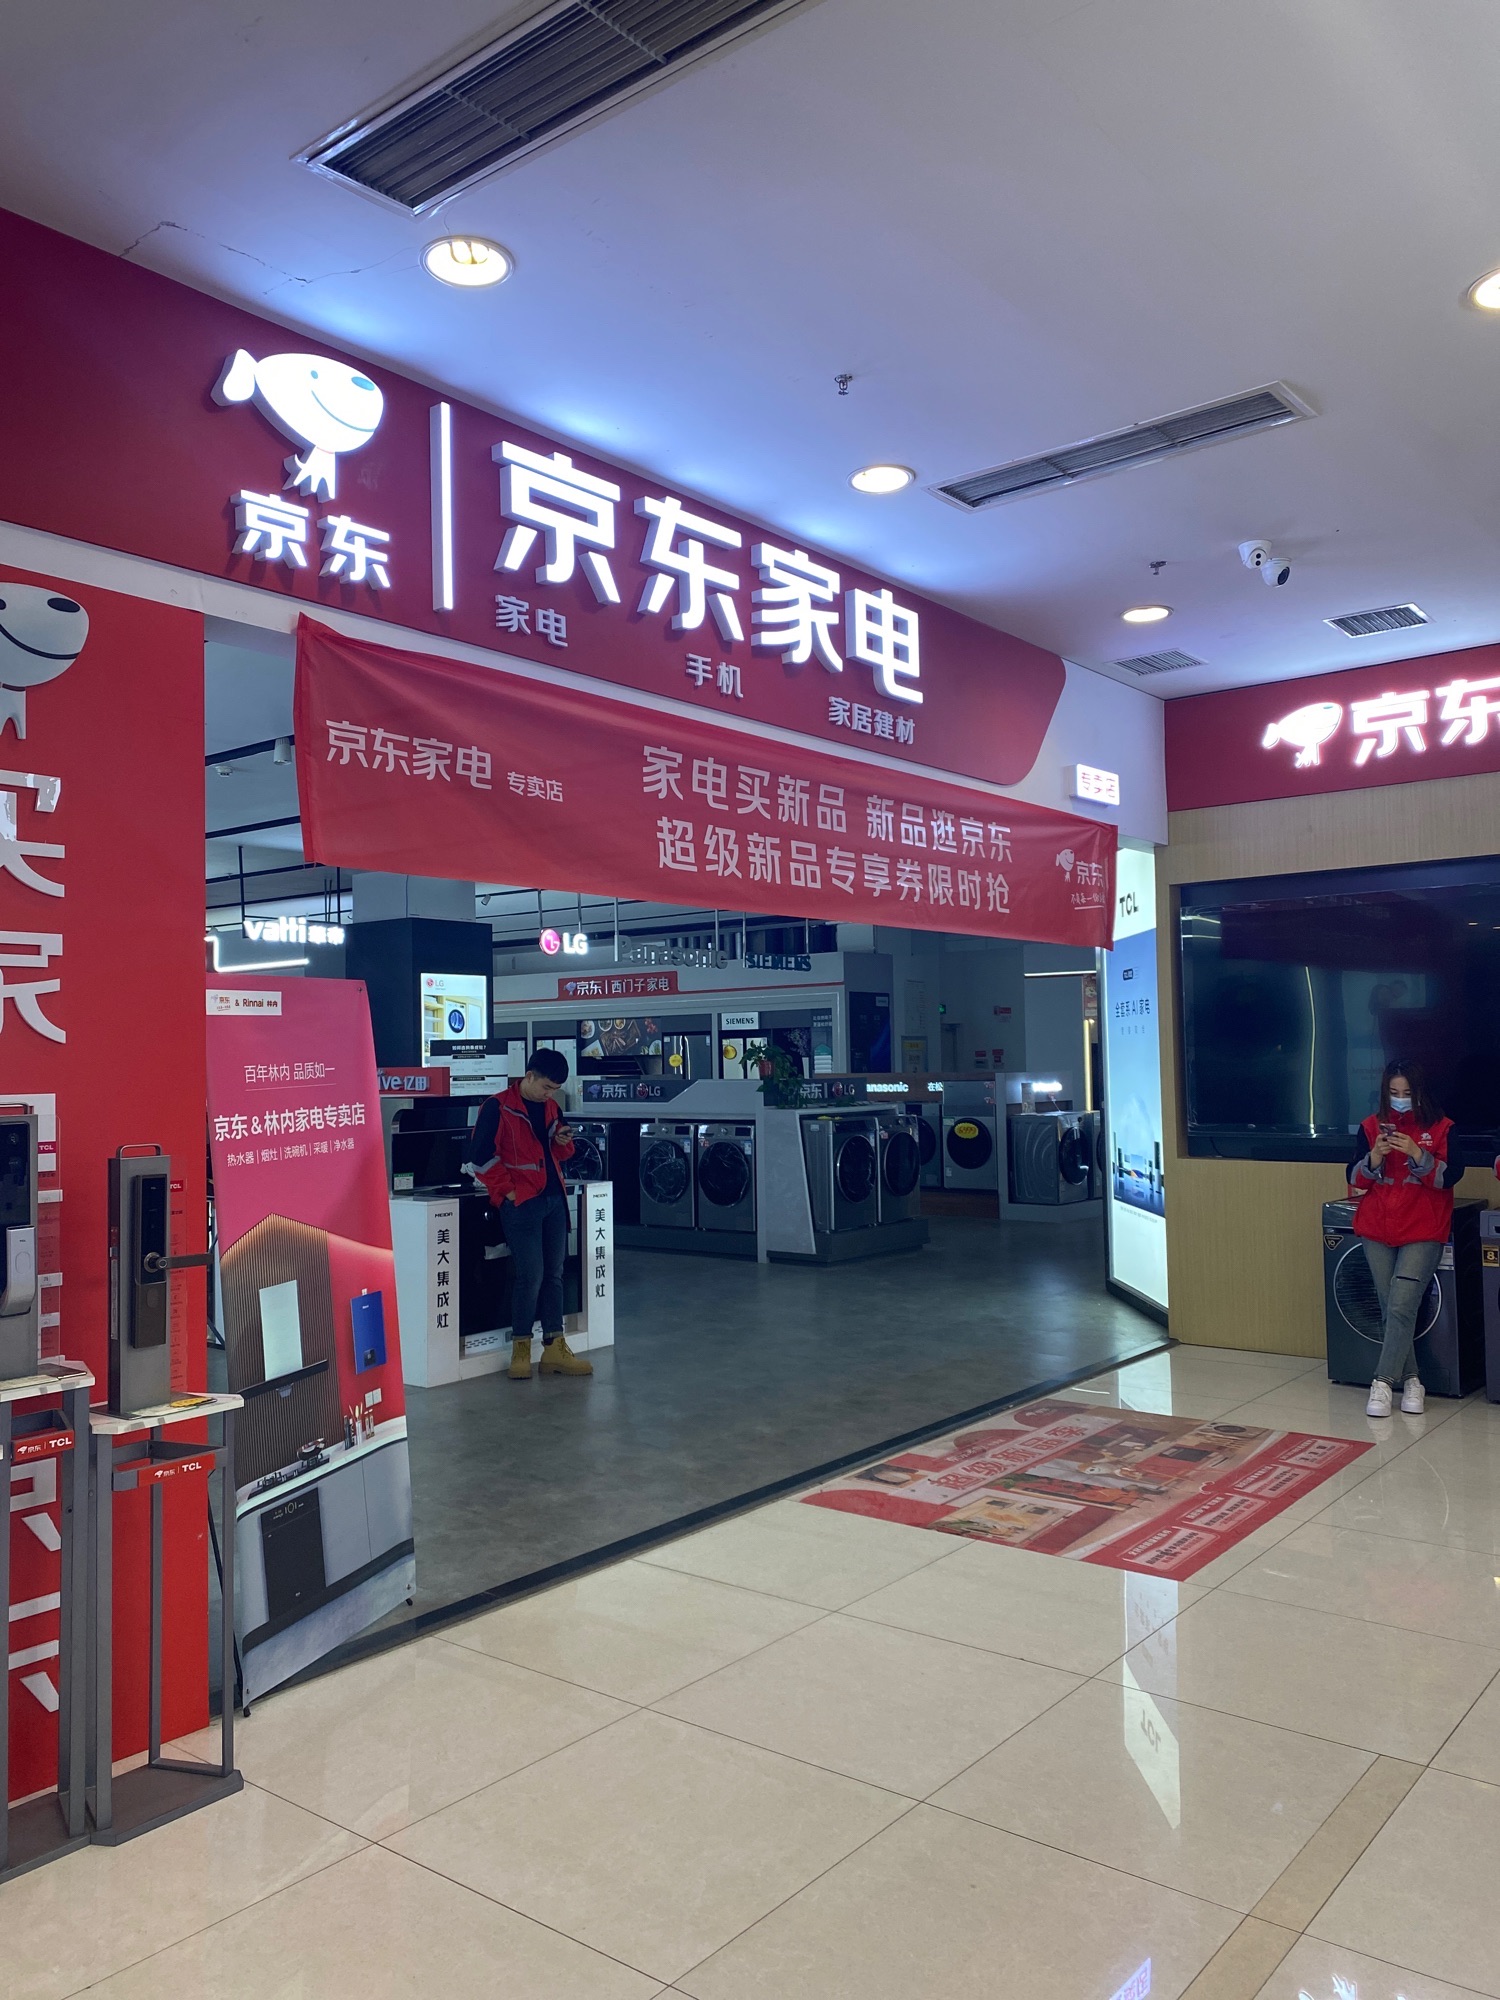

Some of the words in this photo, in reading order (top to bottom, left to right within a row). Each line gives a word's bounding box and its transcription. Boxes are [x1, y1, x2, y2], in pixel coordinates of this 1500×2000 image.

[234, 489, 391, 589] 京东
[493, 440, 924, 704] 京东家电
[495, 594, 568, 648] 家电
[686, 653, 743, 698] 手机
[828, 695, 916, 746] 家居建材
[1350, 677, 1500, 765] 京东
[325, 719, 492, 790] 京东家电
[507, 770, 563, 802] 专卖店
[642, 745, 847, 834] 家电买新品
[866, 794, 1013, 863] 新品逛京东
[656, 816, 1011, 914] 超级新品专享券限时抢
[1076, 860, 1103, 888] 京东
[1119, 891, 1139, 918] TCL
[562, 932, 588, 956] LG
[617, 934, 728, 969] Panasonic
[745, 952, 812, 972] SIEMENS
[576, 980, 602, 996] 京东
[611, 977, 670, 994] 西门子家电
[242, 998, 264, 1008] Rinnai
[725, 1017, 754, 1026] SIEMENS
[244, 1063, 290, 1084] 百年林内
[293, 1062, 336, 1080] 品质如一
[866, 1081, 909, 1093] anasonic
[602, 1084, 627, 1098] 京东
[649, 1086, 660, 1096] LG
[843, 1084, 855, 1096] LG
[227, 1151, 255, 1167] 热水器
[284, 1143, 308, 1159] 洗碗机
[313, 1140, 329, 1155] 采暖
[333, 1137, 355, 1152] 净水器
[595, 1208, 606, 1298] 美大集成灶
[436, 1228, 450, 1329] 美大集成灶
[49, 1437, 72, 1449] TCL
[182, 1462, 202, 1473] TCL
